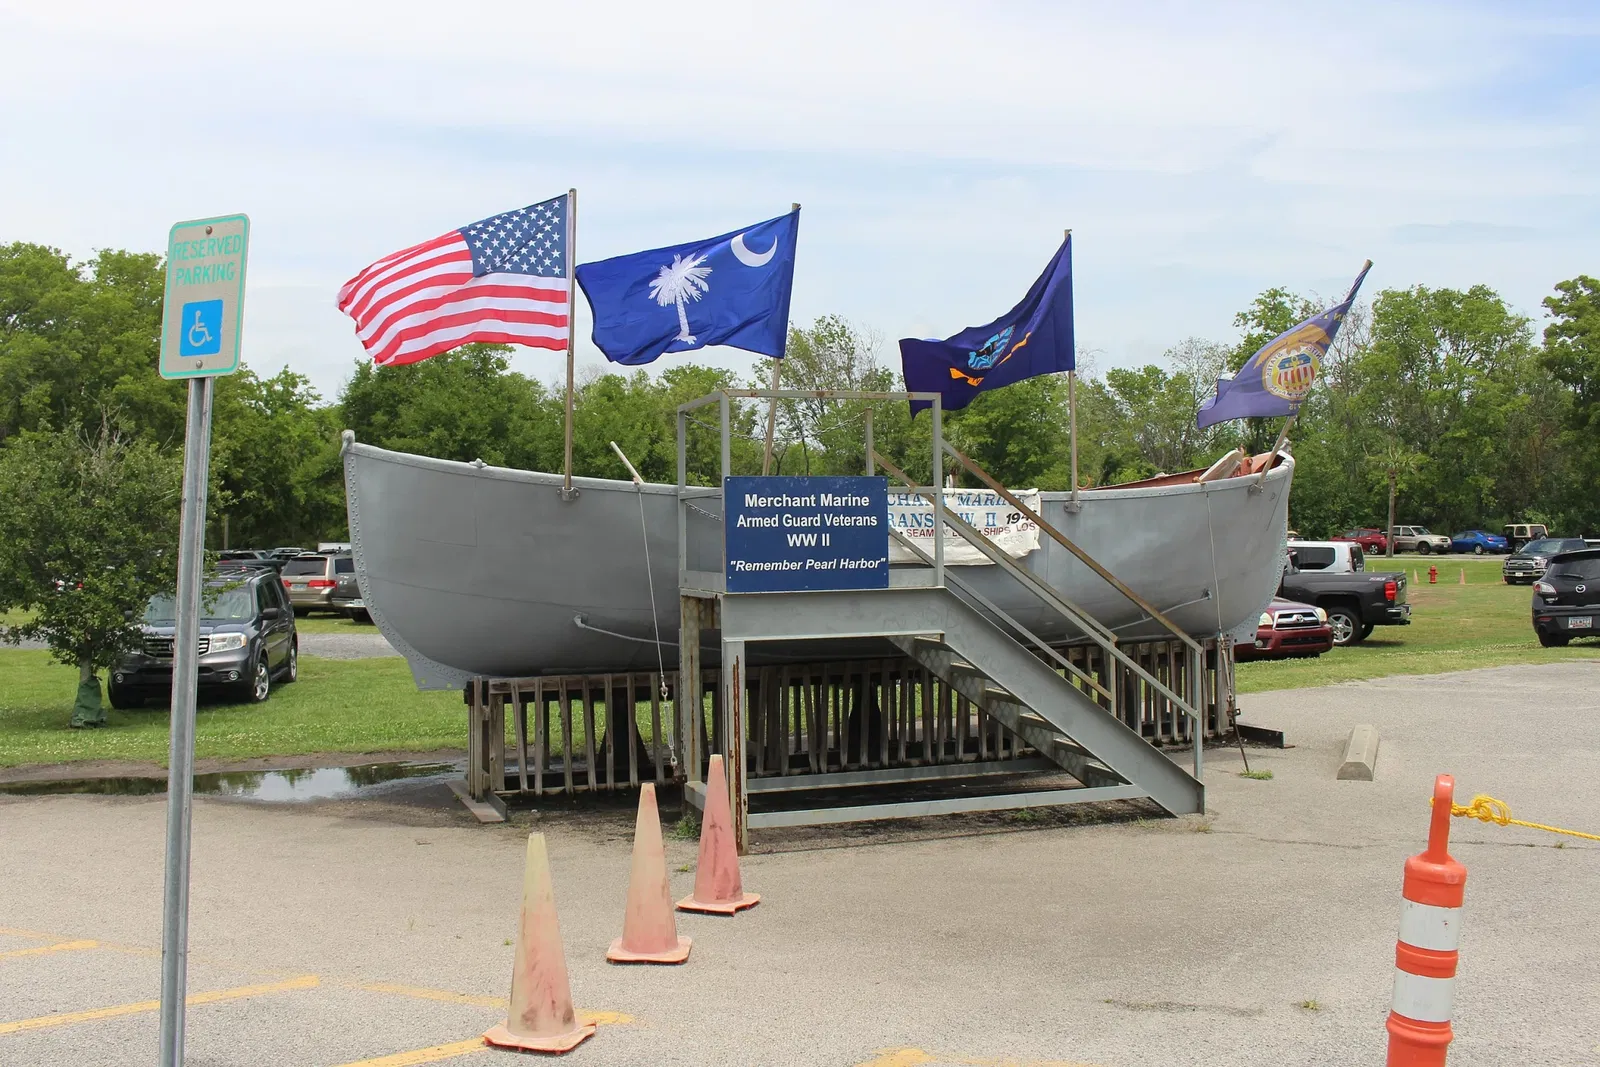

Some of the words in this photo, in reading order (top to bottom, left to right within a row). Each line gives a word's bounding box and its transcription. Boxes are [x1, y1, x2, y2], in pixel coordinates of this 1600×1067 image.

[173, 234, 241, 261] RESERVED
[175, 261, 236, 286] PARKING
[745, 493, 816, 508] Merchant
[820, 493, 870, 507] Marine
[736, 514, 779, 528] Armed
[782, 513, 821, 527] Guard
[824, 513, 878, 527] Veterans
[983, 526, 1011, 537] SHIPS
[786, 533, 817, 547] WW
[821, 533, 830, 547] II
[730, 560, 803, 572] "Remember
[805, 558, 837, 570] Pearl
[839, 557, 886, 569] Harbor"
